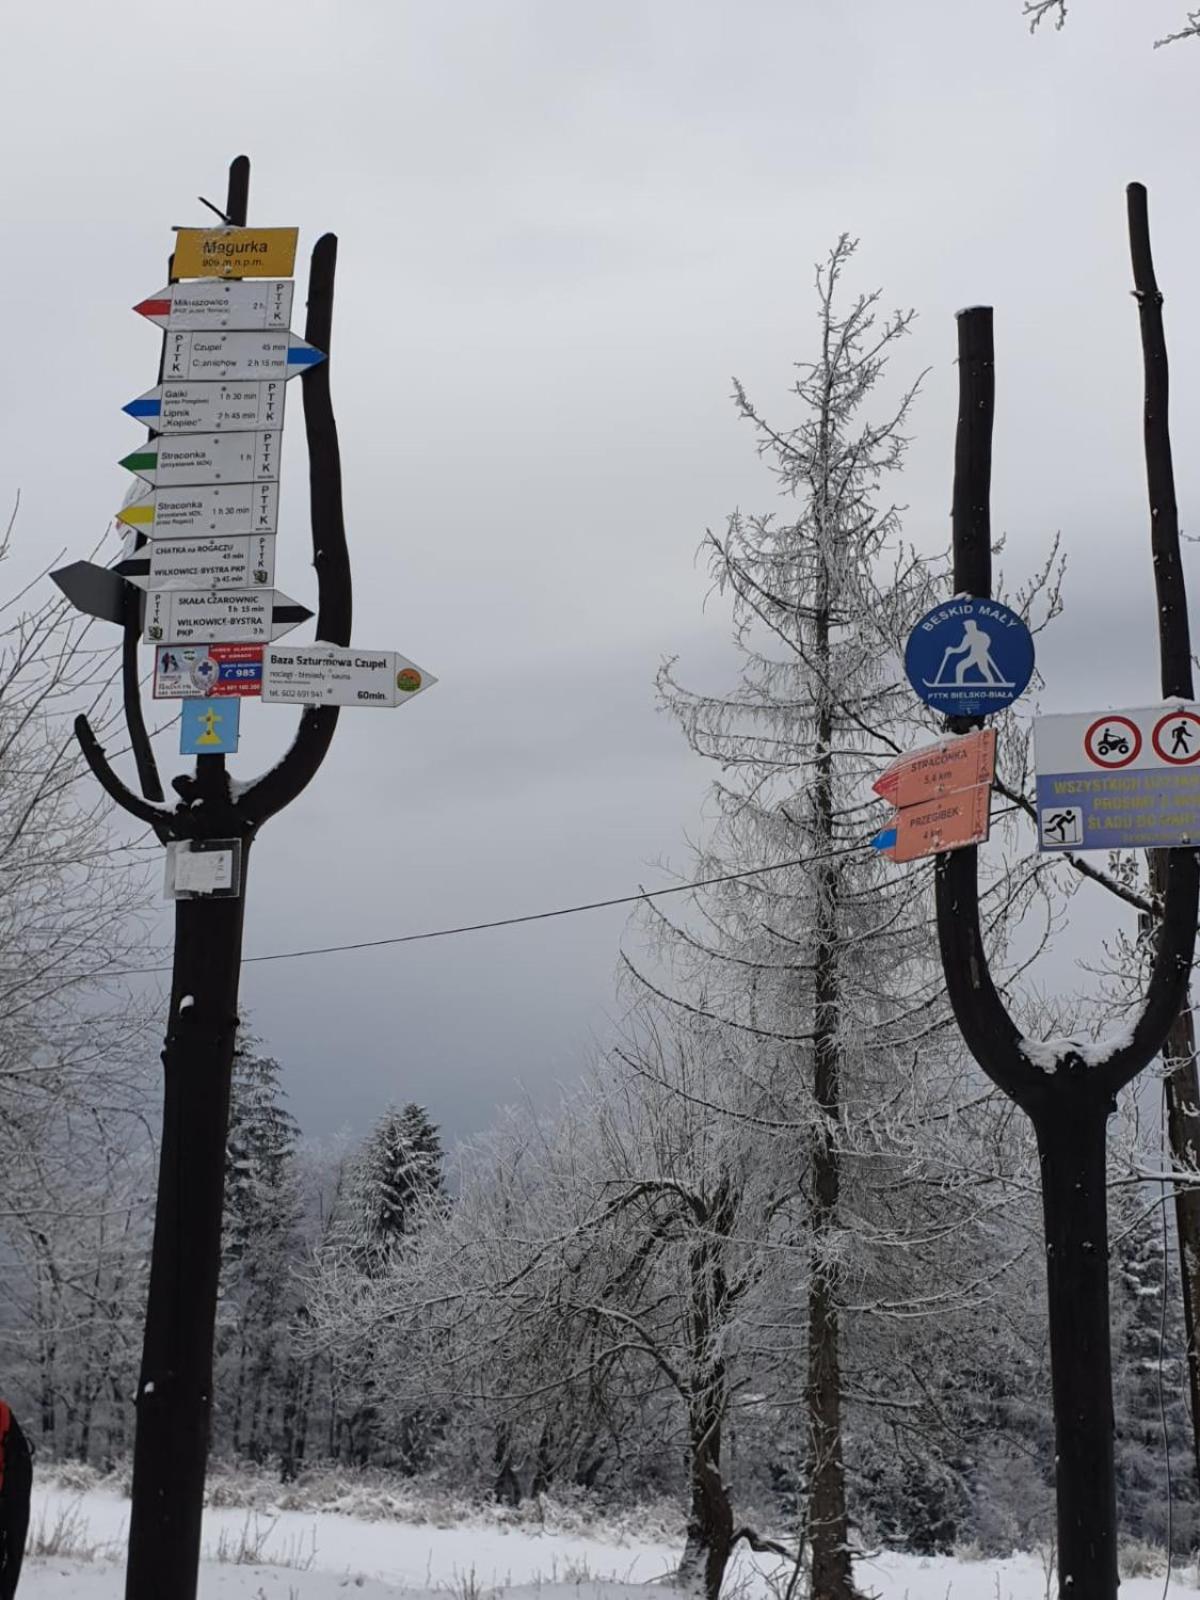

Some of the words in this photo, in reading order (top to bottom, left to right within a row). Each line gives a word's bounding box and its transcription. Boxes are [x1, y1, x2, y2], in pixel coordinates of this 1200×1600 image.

[202, 241, 268, 256] Magurka
[194, 343, 222, 352] Czupel
[266, 383, 276, 422] PTTK
[164, 410, 190, 418] Lipnik
[161, 451, 206, 460] Straconka
[262, 434, 272, 472] PTTK
[158, 502, 203, 510] Straconka
[236, 506, 250, 514] min
[260, 486, 270, 524] PTTK
[155, 547, 186, 555] CHATKA
[258, 538, 266, 568] PTTK
[178, 597, 206, 605] SKAŁA
[207, 596, 259, 604] CZAROWNIC
[922, 604, 974, 632] BESKID
[978, 606, 1018, 629] MAŁY
[176, 629, 194, 637] PKP
[270, 655, 294, 665] Baza
[296, 656, 352, 667] Szturmowa
[354, 658, 386, 670] Czupel
[236, 669, 256, 677] 985
[928, 692, 948, 700] PTTK
[950, 691, 1014, 699] BIELSKO-BIAŁA
[911, 750, 968, 772] STRACONKA
[938, 772, 952, 781] km
[910, 806, 959, 828] PRZEGIBEK
[930, 828, 942, 838] km
